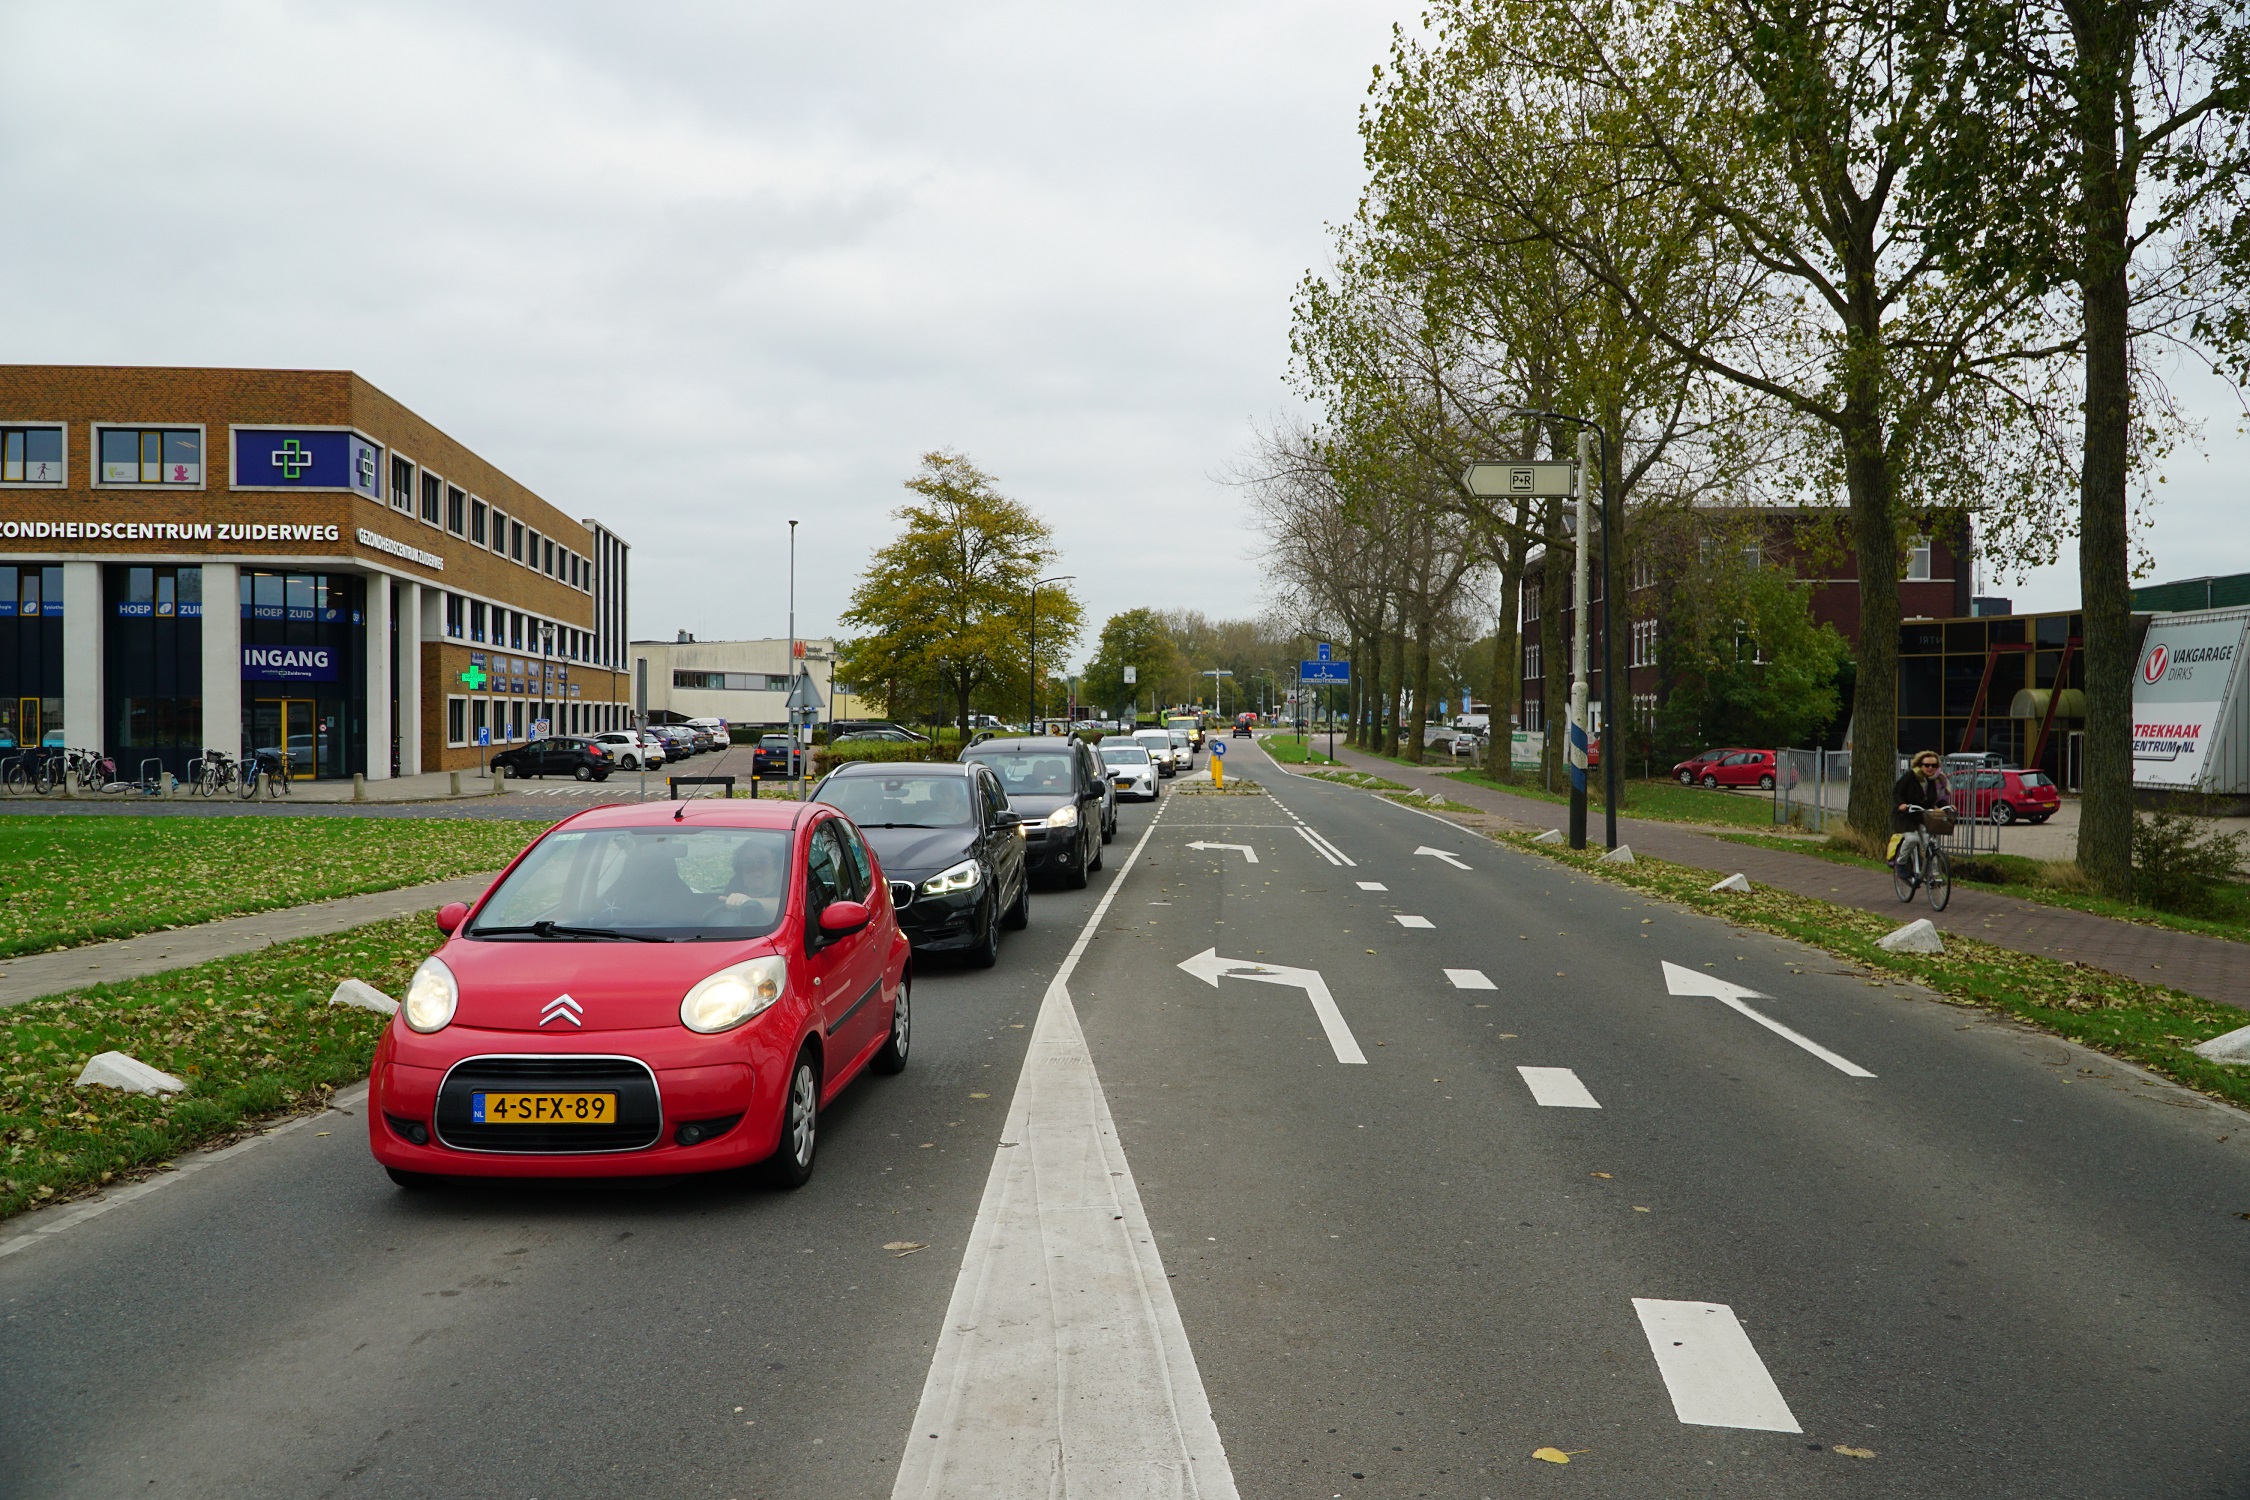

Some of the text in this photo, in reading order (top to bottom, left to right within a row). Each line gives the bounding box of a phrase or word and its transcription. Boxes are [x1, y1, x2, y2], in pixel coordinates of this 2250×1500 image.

[217, 524, 339, 541] ZUIDERWEG
[359, 527, 444, 571] GEZONDHEIDSCENTRUM ZUIDERWEG
[119, 605, 151, 614] HOEP
[255, 607, 314, 619] HOEP ZUID
[244, 649, 329, 668] INGANG
[2173, 645, 2234, 664] VAKGARAGE
[2168, 666, 2194, 681] DIRKS
[2134, 724, 2202, 739] TREKHAAK
[474, 1097, 605, 1119] NL 4-SFX-89
